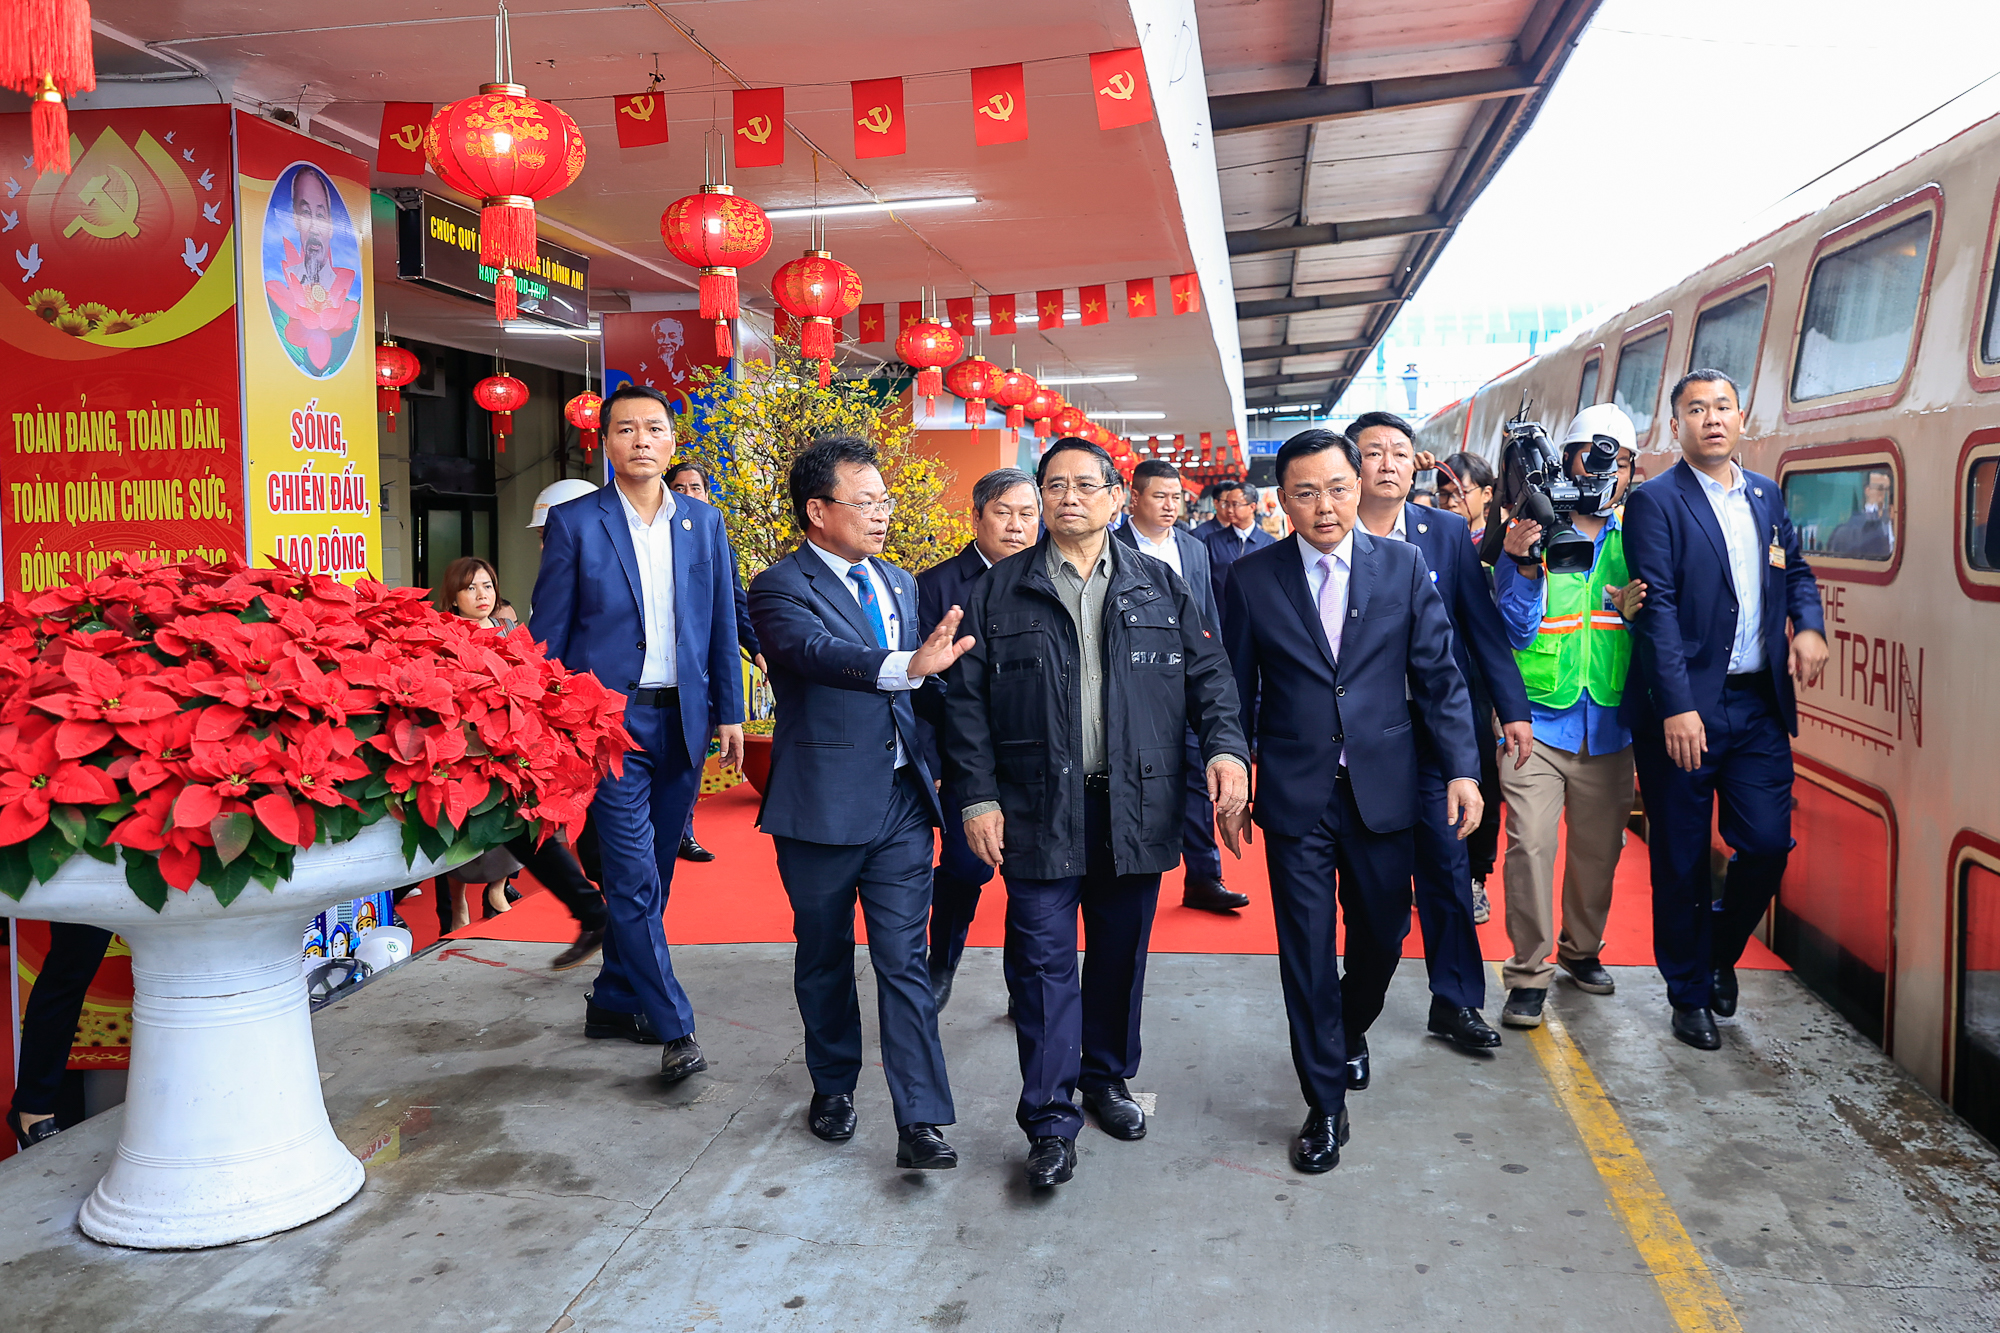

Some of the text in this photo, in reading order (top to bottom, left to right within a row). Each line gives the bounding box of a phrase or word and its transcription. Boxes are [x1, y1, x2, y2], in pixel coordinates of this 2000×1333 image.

[430, 215, 456, 246] CHÚC
[458, 226, 476, 253] QUÝ
[542, 256, 551, 283] LỘ
[551, 260, 570, 286] BÌNH
[571, 269, 584, 291] AN!
[12, 392, 226, 457] TOÀN ĐẢNG, TOÀN DÂN,
[290, 398, 347, 457] SỐNG,
[11, 466, 233, 527] TOÀN QUÂN CHUNG SỨC,
[267, 459, 370, 517] CHIẾN ĐẤU,
[276, 534, 313, 574] LAO
[317, 525, 367, 581] ĐỘNG
[1834, 629, 1925, 748] TRAIN
